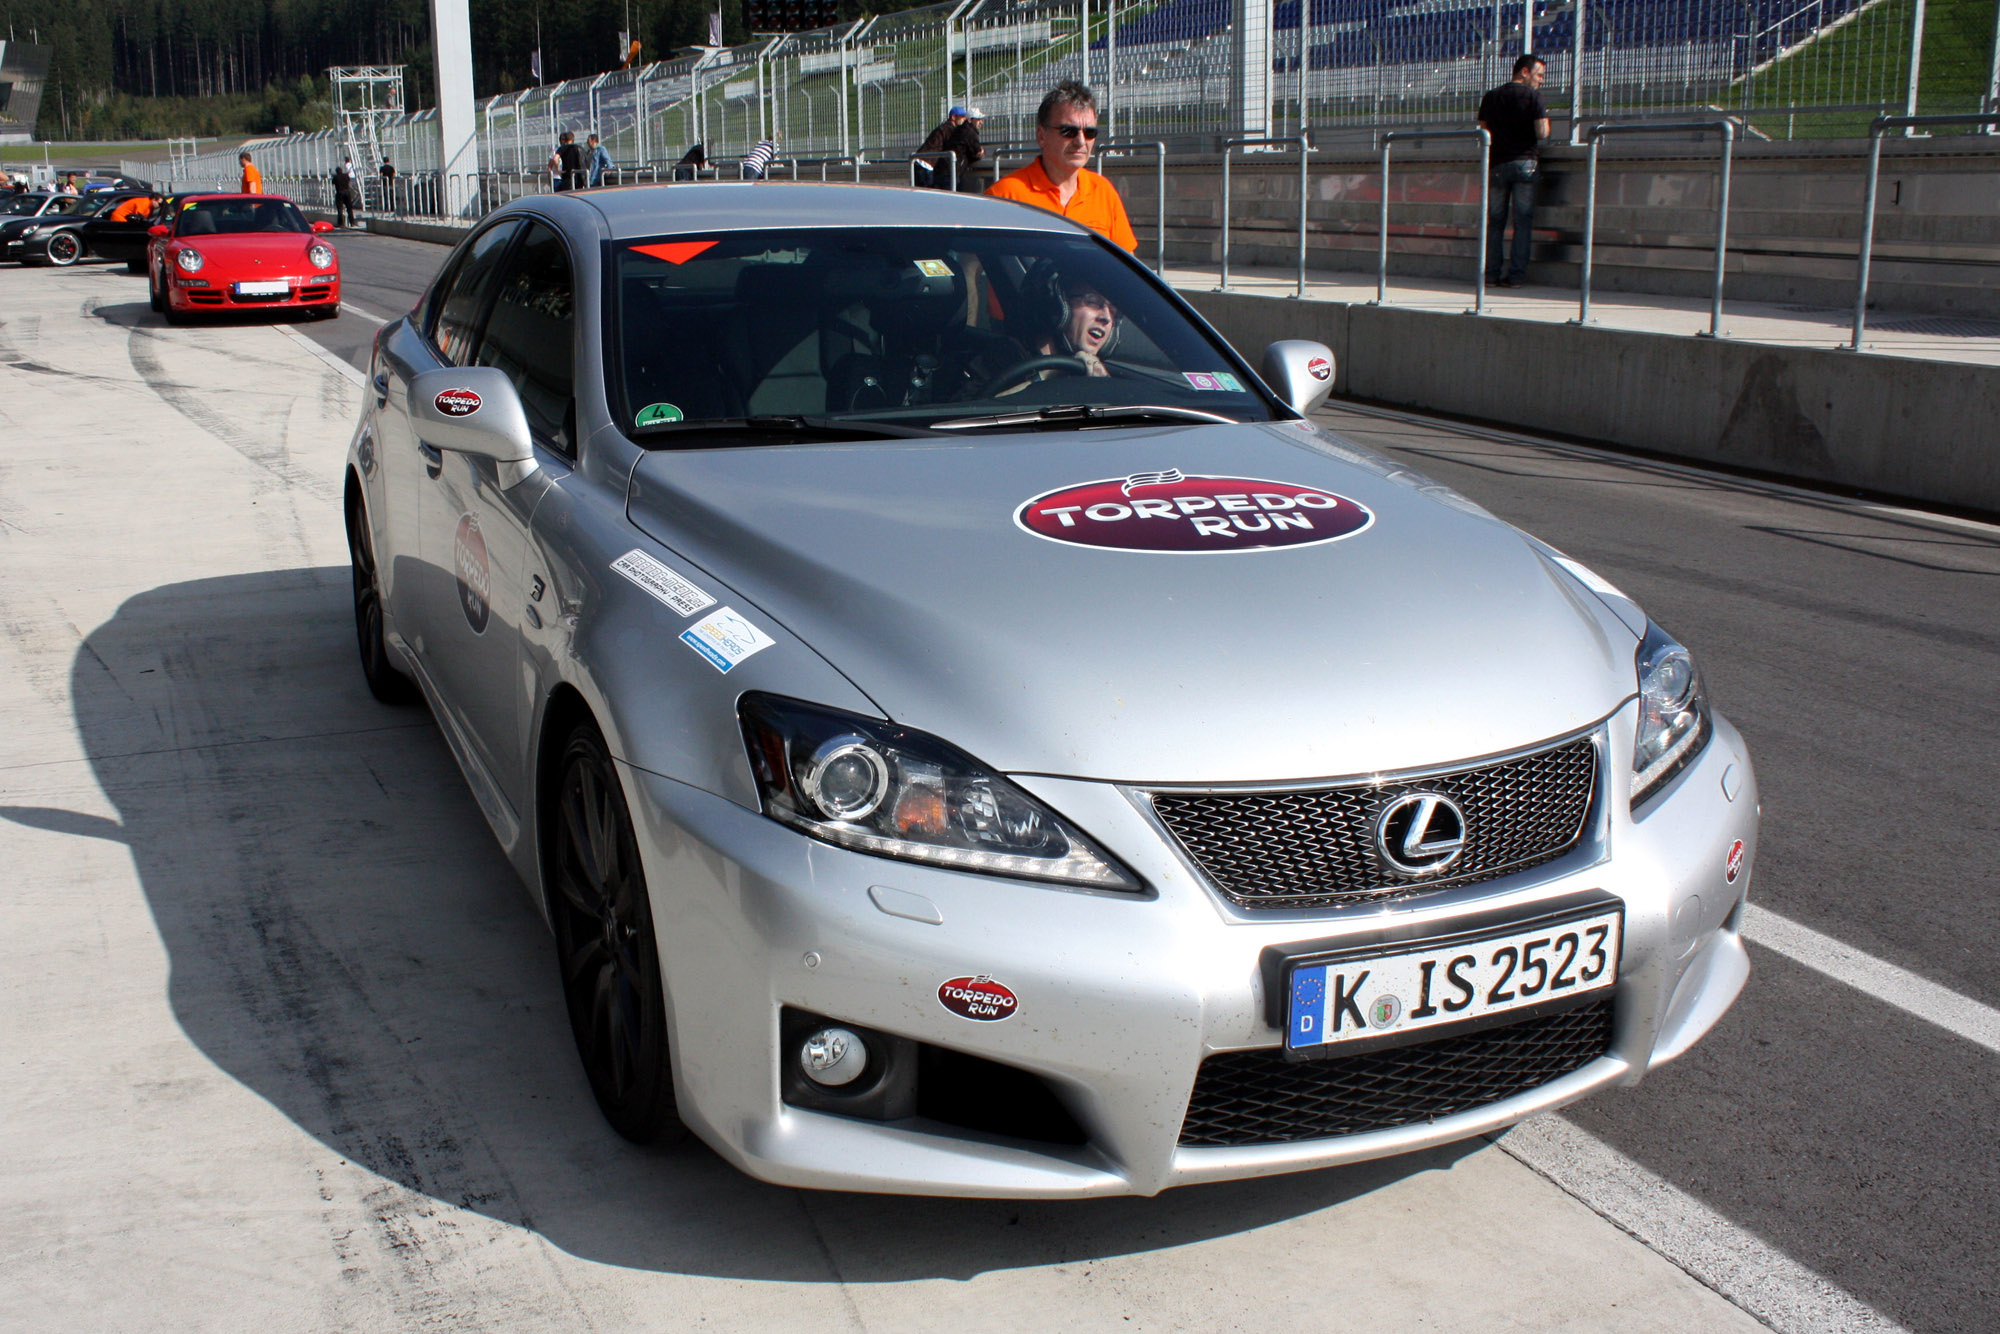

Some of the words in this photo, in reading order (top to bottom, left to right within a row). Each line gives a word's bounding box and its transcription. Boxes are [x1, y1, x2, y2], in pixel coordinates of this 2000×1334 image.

[438, 396, 480, 406] TORPEDO
[450, 404, 470, 412] RUN
[652, 405, 666, 418] 4
[1040, 493, 1338, 528] TORPEDO
[1189, 511, 1315, 538] RUN
[671, 595, 694, 613] PRESS
[1333, 970, 1371, 1032] K
[1487, 924, 1609, 1005] 2523
[944, 986, 1014, 1007] TORPEDO
[967, 1002, 999, 1016] RUN
[1300, 1015, 1312, 1033] D
